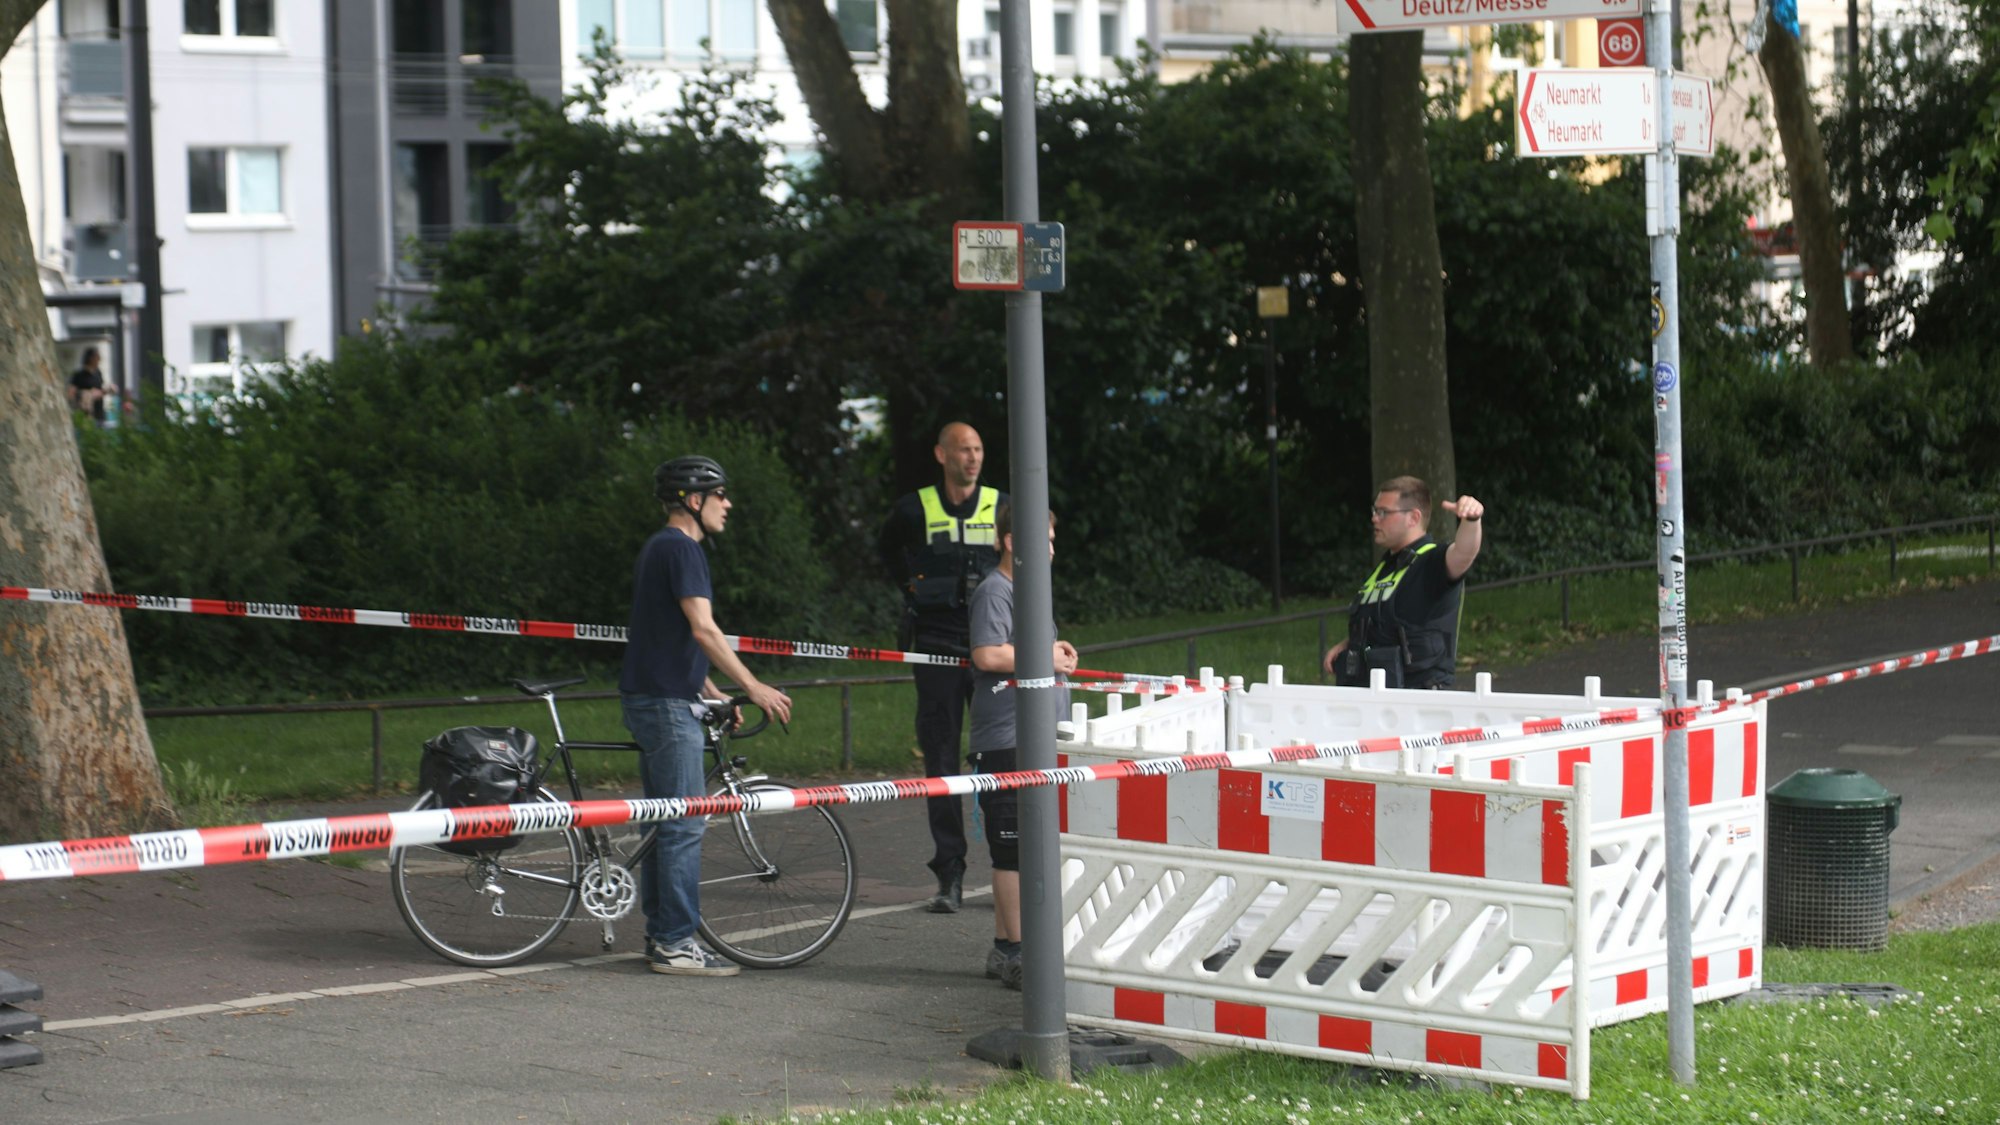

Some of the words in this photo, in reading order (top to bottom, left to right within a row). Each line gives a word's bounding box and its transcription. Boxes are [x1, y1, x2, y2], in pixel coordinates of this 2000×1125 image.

[1608, 34, 1633, 53] 68
[1546, 82, 1602, 105] Neumarkt
[1547, 119, 1603, 143] Heumarkt
[959, 230, 968, 244] H
[976, 230, 1002, 245] 500
[1266, 780, 1319, 803] KTS
[439, 804, 582, 838] ORDNUNGSAMT
[241, 820, 392, 855] ORDNUNGSAMT
[25, 835, 188, 872] ORDNUNGSAMT
